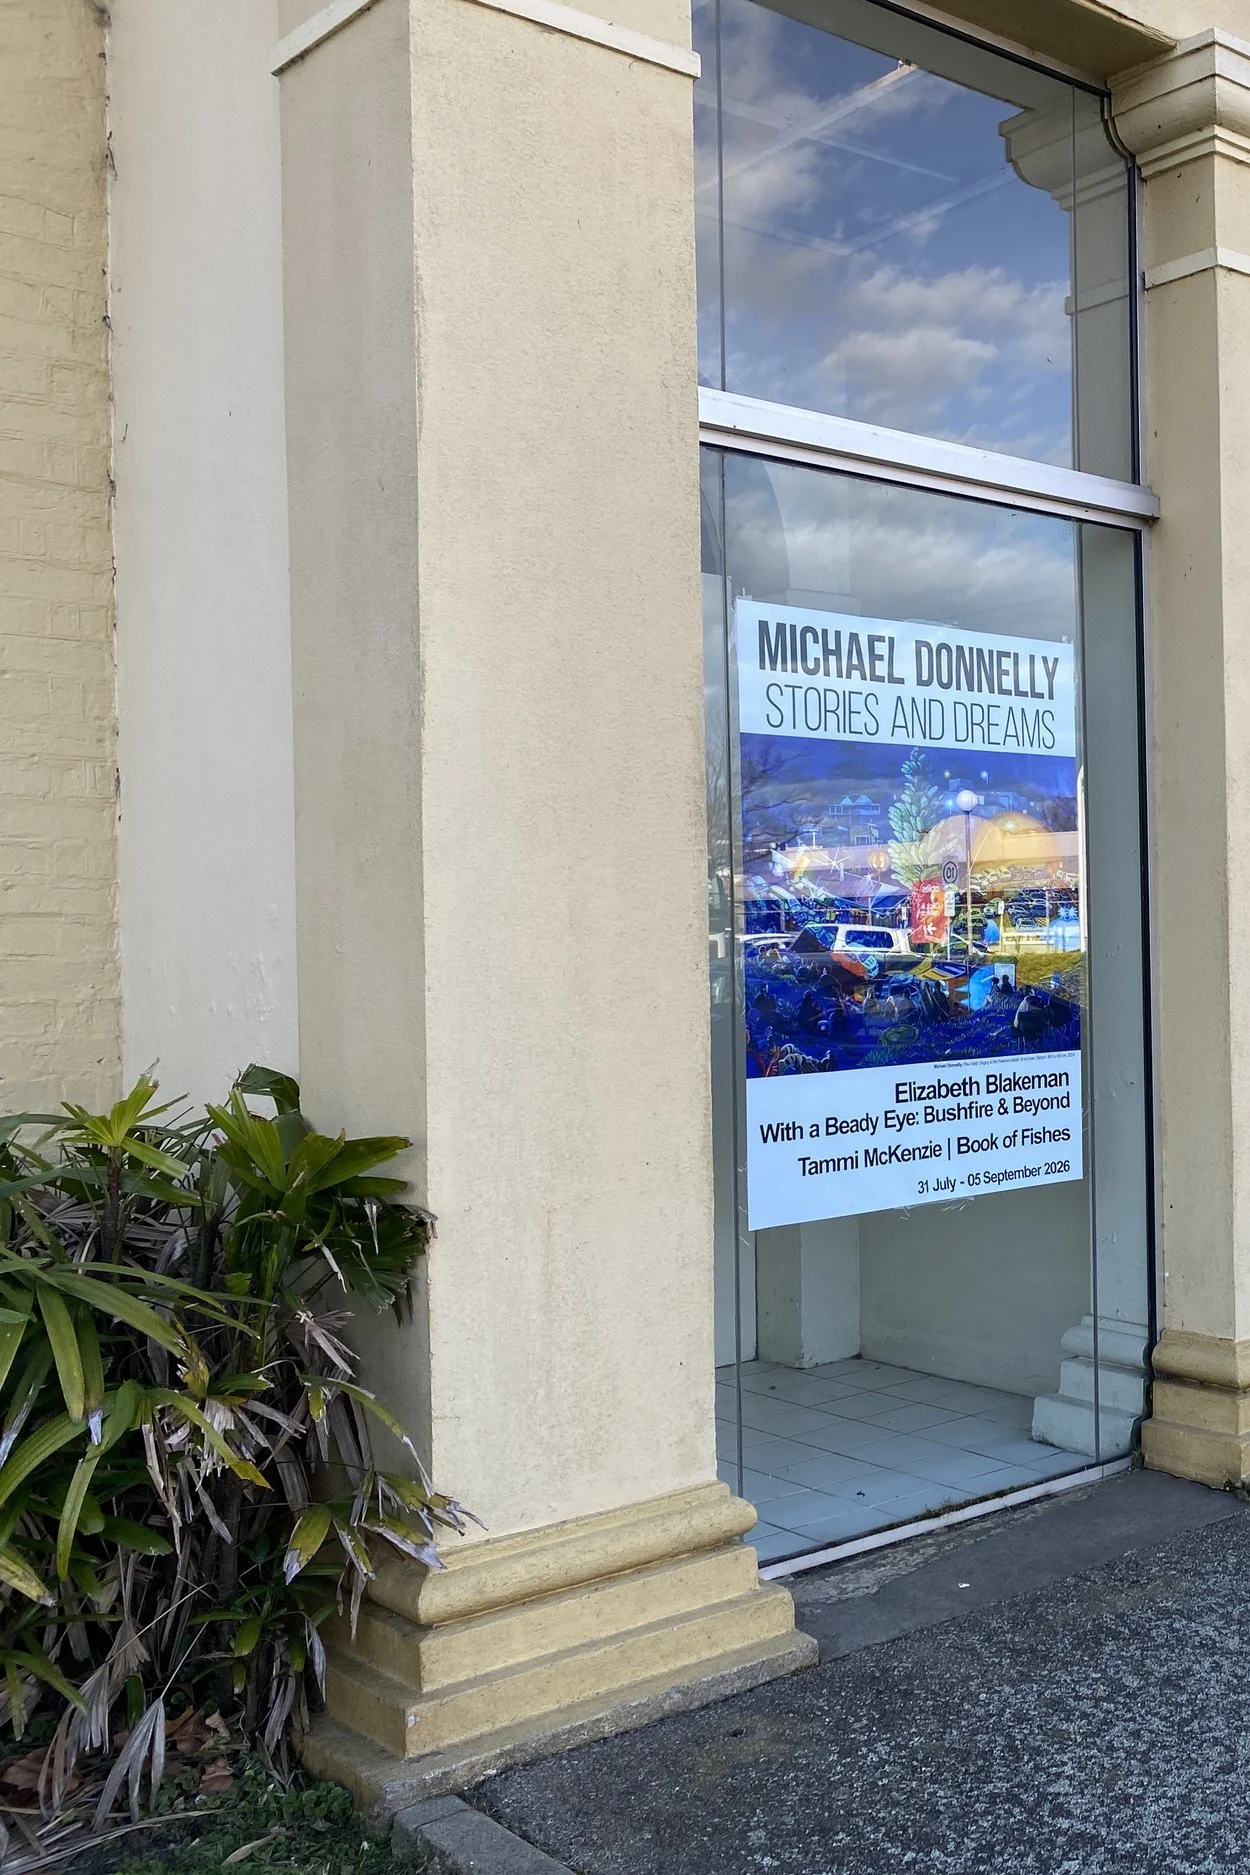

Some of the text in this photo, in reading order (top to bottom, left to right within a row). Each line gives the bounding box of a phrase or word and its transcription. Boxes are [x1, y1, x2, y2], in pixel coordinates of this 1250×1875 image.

[758, 619, 1060, 701] MICHAEL DONNELLY
[765, 682, 1056, 750] STORIES AND DREAMS
[895, 1071, 1070, 1104] Elizabeth Blakeman
[759, 1091, 1071, 1144] With a Beady Eye: Bushfire & Beyond
[797, 1150, 859, 1177] Tammi
[864, 1140, 943, 1167] McKenzie
[957, 1133, 999, 1156] Book
[1002, 1130, 1018, 1149] of
[1021, 1125, 1071, 1146] Fishes
[917, 1180, 930, 1194] 31
[932, 1177, 957, 1193] July
[967, 1173, 981, 1187] 05
[983, 1165, 1042, 1186] September
[1044, 1160, 1071, 1176] 2026
